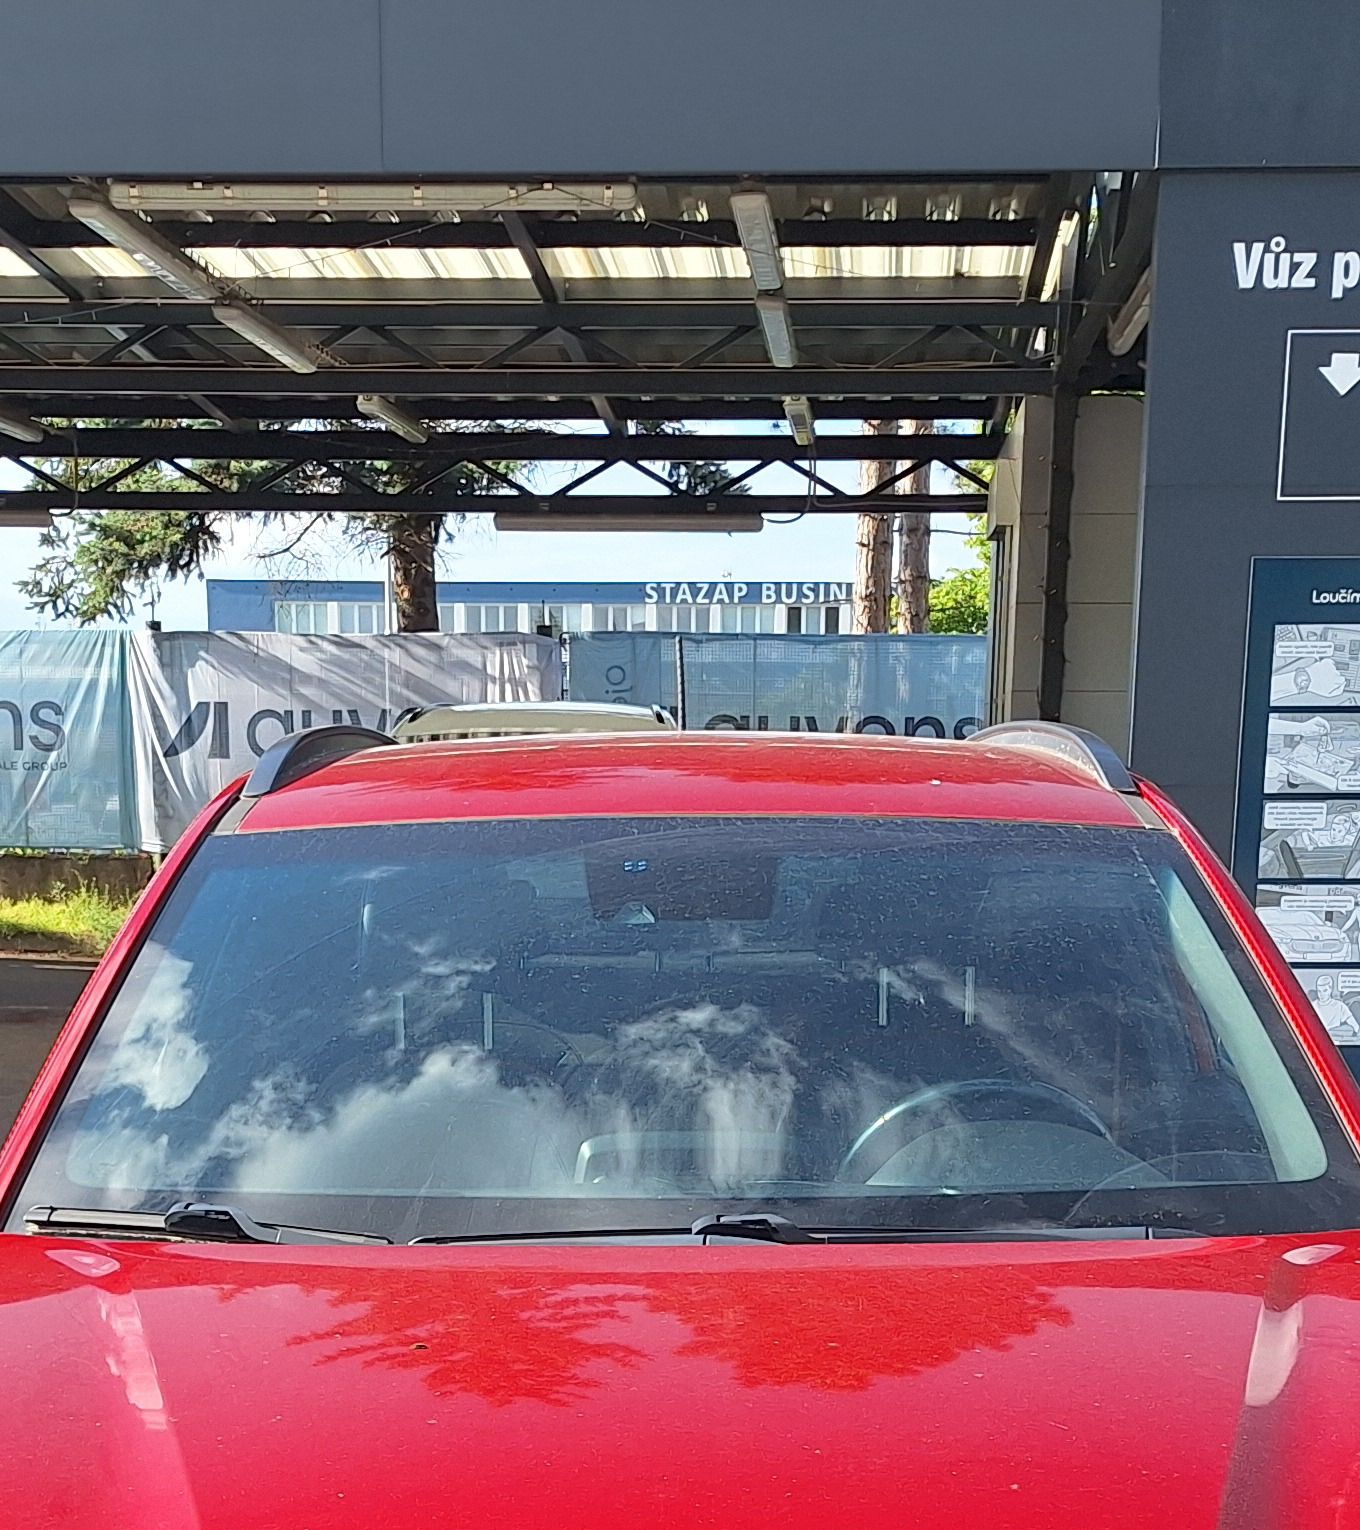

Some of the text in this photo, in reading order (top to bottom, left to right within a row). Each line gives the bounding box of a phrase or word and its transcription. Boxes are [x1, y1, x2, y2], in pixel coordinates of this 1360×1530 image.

[1233, 236, 1318, 289] Vůz
[644, 583, 748, 604] STAZAP
[22, 761, 68, 772] GROUP
